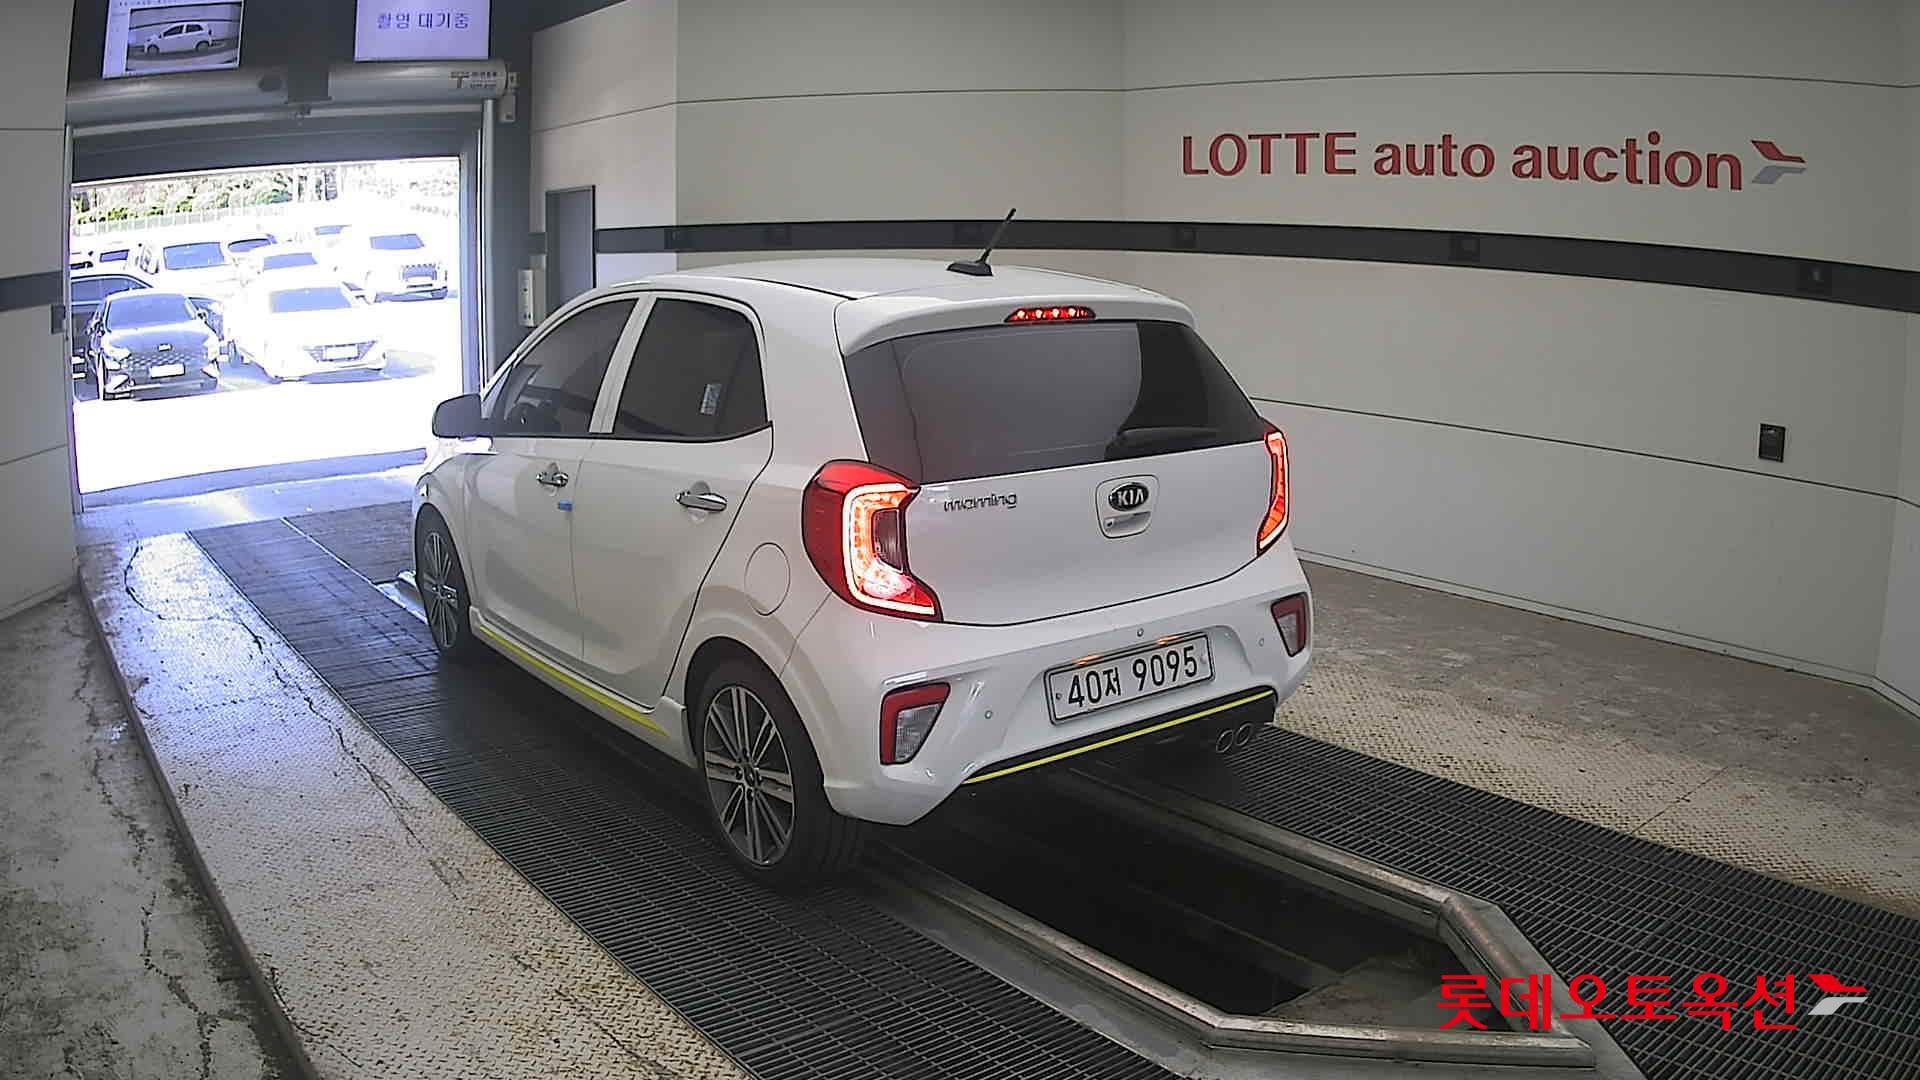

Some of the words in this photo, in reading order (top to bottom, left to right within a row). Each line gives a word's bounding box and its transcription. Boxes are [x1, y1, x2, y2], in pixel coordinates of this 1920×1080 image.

[418, 12, 469, 29] 대기중
[1182, 132, 1357, 177] LOTTE
[1374, 134, 1496, 178] auto
[1512, 131, 1744, 190] auction
[1116, 486, 1145, 507] KIA
[1068, 668, 1122, 708] 40저
[1132, 645, 1198, 692] 9095
